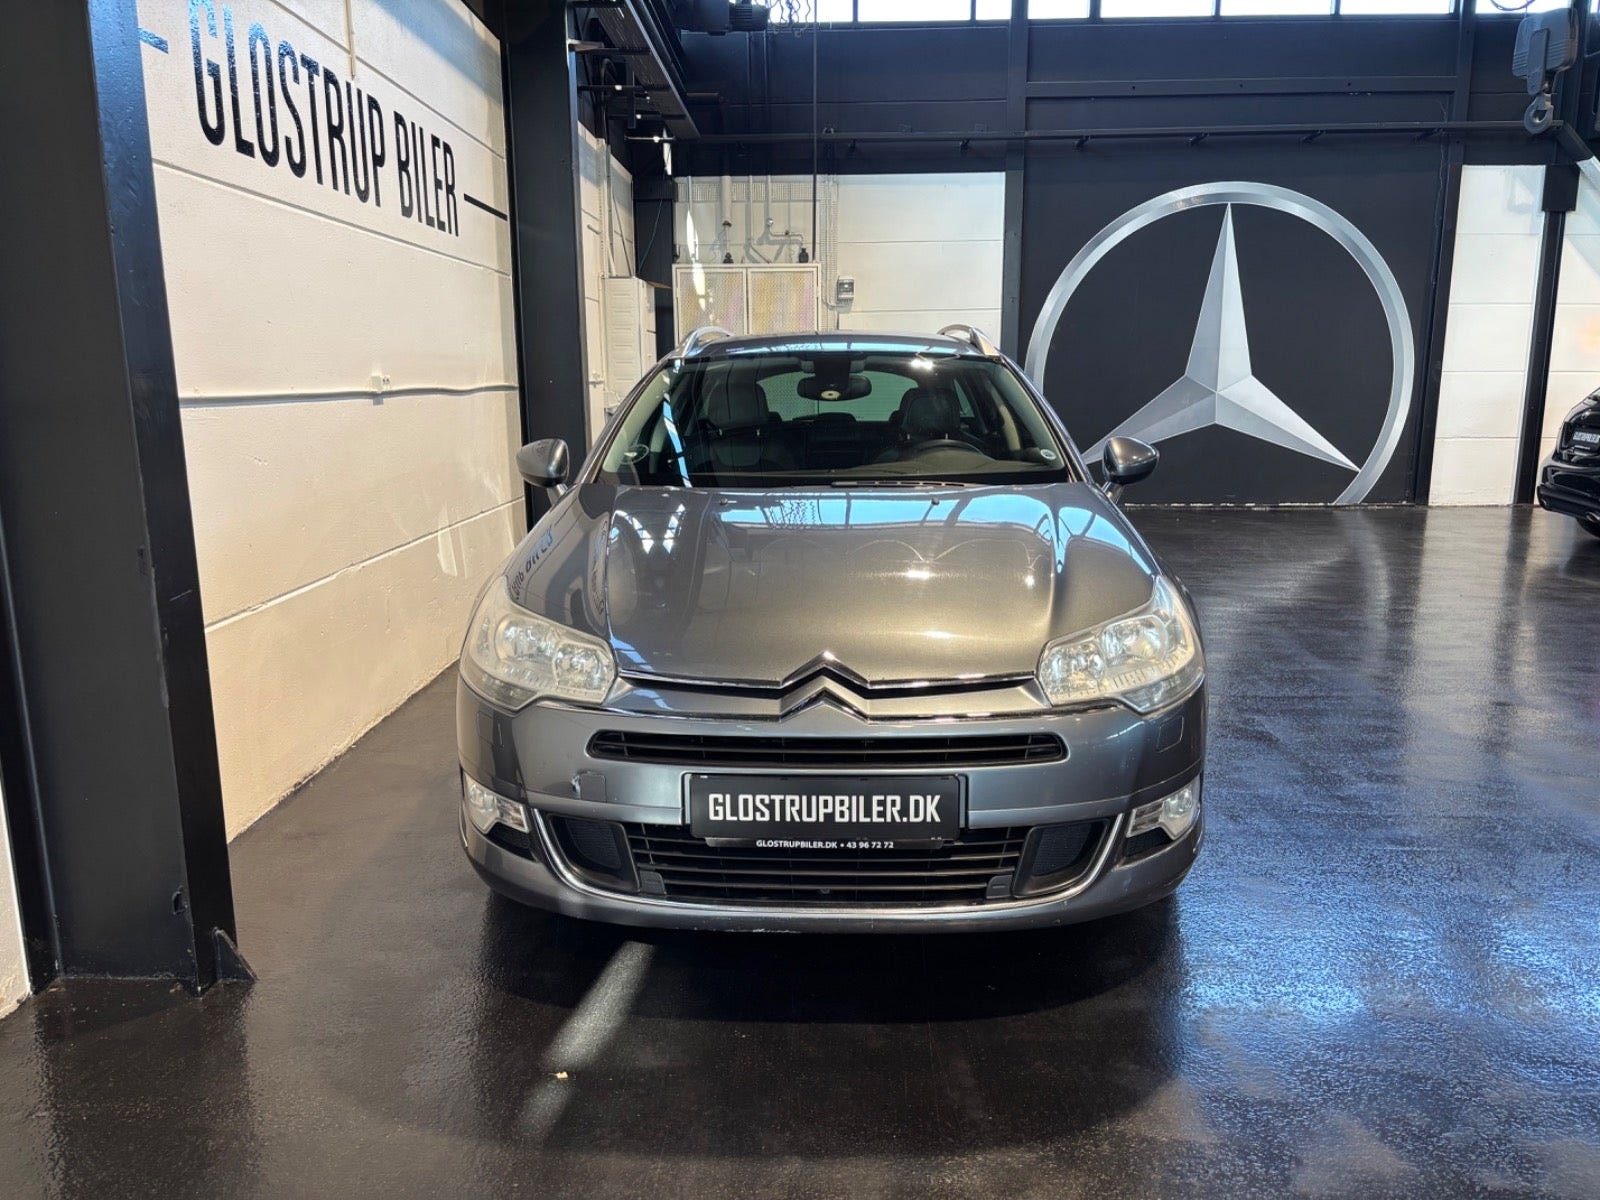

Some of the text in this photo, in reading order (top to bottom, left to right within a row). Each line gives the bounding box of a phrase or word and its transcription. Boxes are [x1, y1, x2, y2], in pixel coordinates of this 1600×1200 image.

[188, 0, 459, 237] GLOSTRUP BILER
[708, 794, 941, 823] GLOSTRUPBILER.DK
[756, 840, 837, 848] GLOSTRUPBILER.DK
